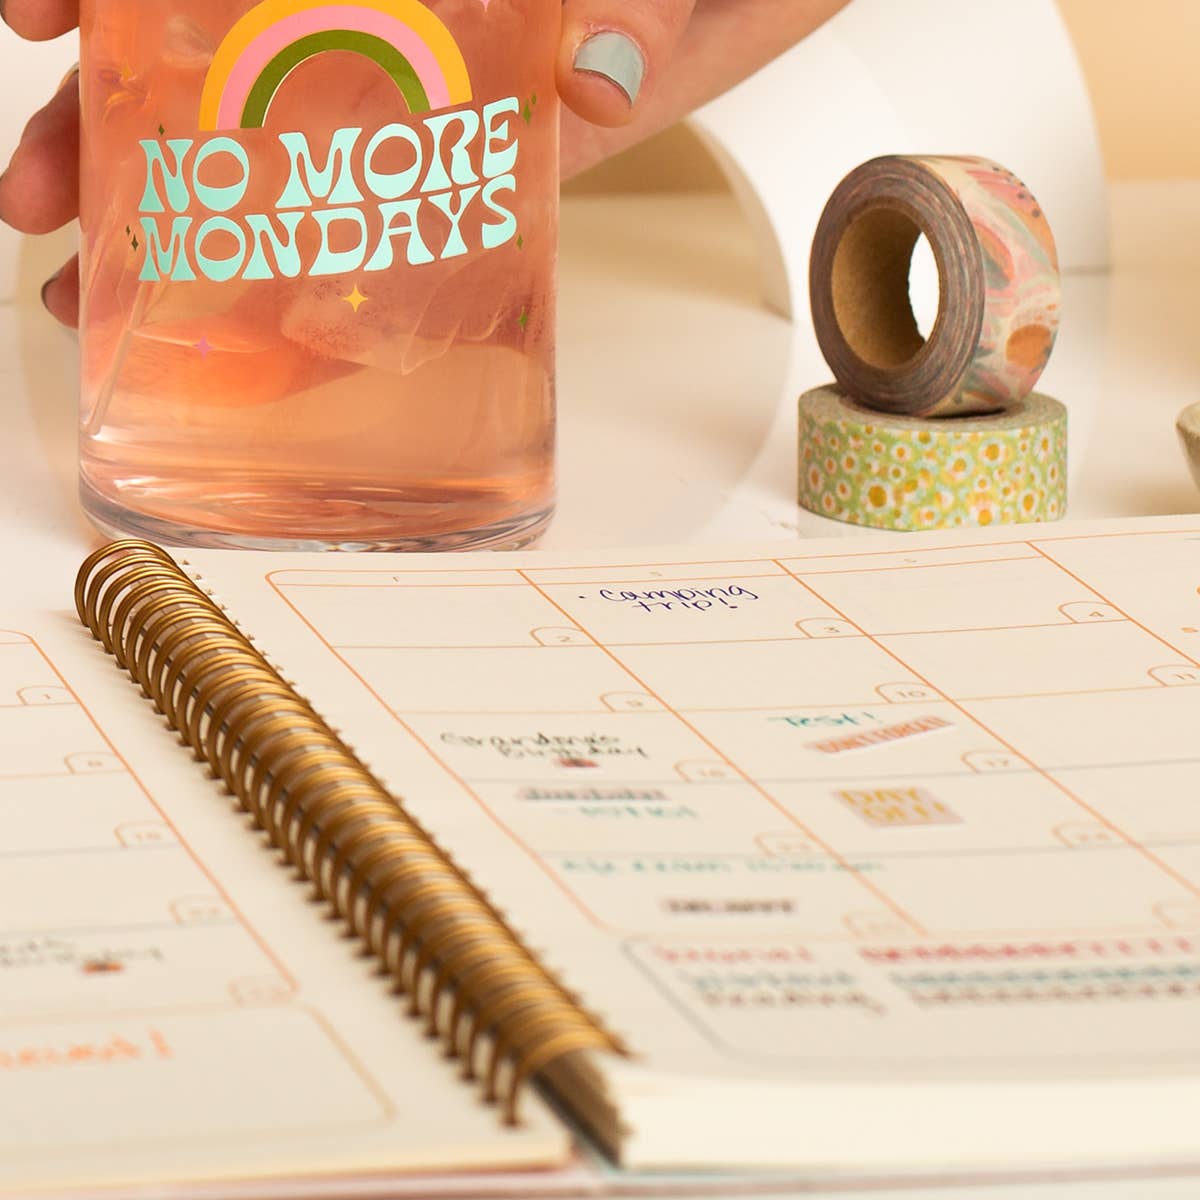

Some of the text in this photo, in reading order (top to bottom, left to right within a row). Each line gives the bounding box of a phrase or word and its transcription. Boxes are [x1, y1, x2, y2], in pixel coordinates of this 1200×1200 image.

[138, 96, 519, 213] NO MORE
[138, 173, 517, 282] MONDAYS
[556, 635, 572, 643] 2
[896, 689, 927, 699] 10
